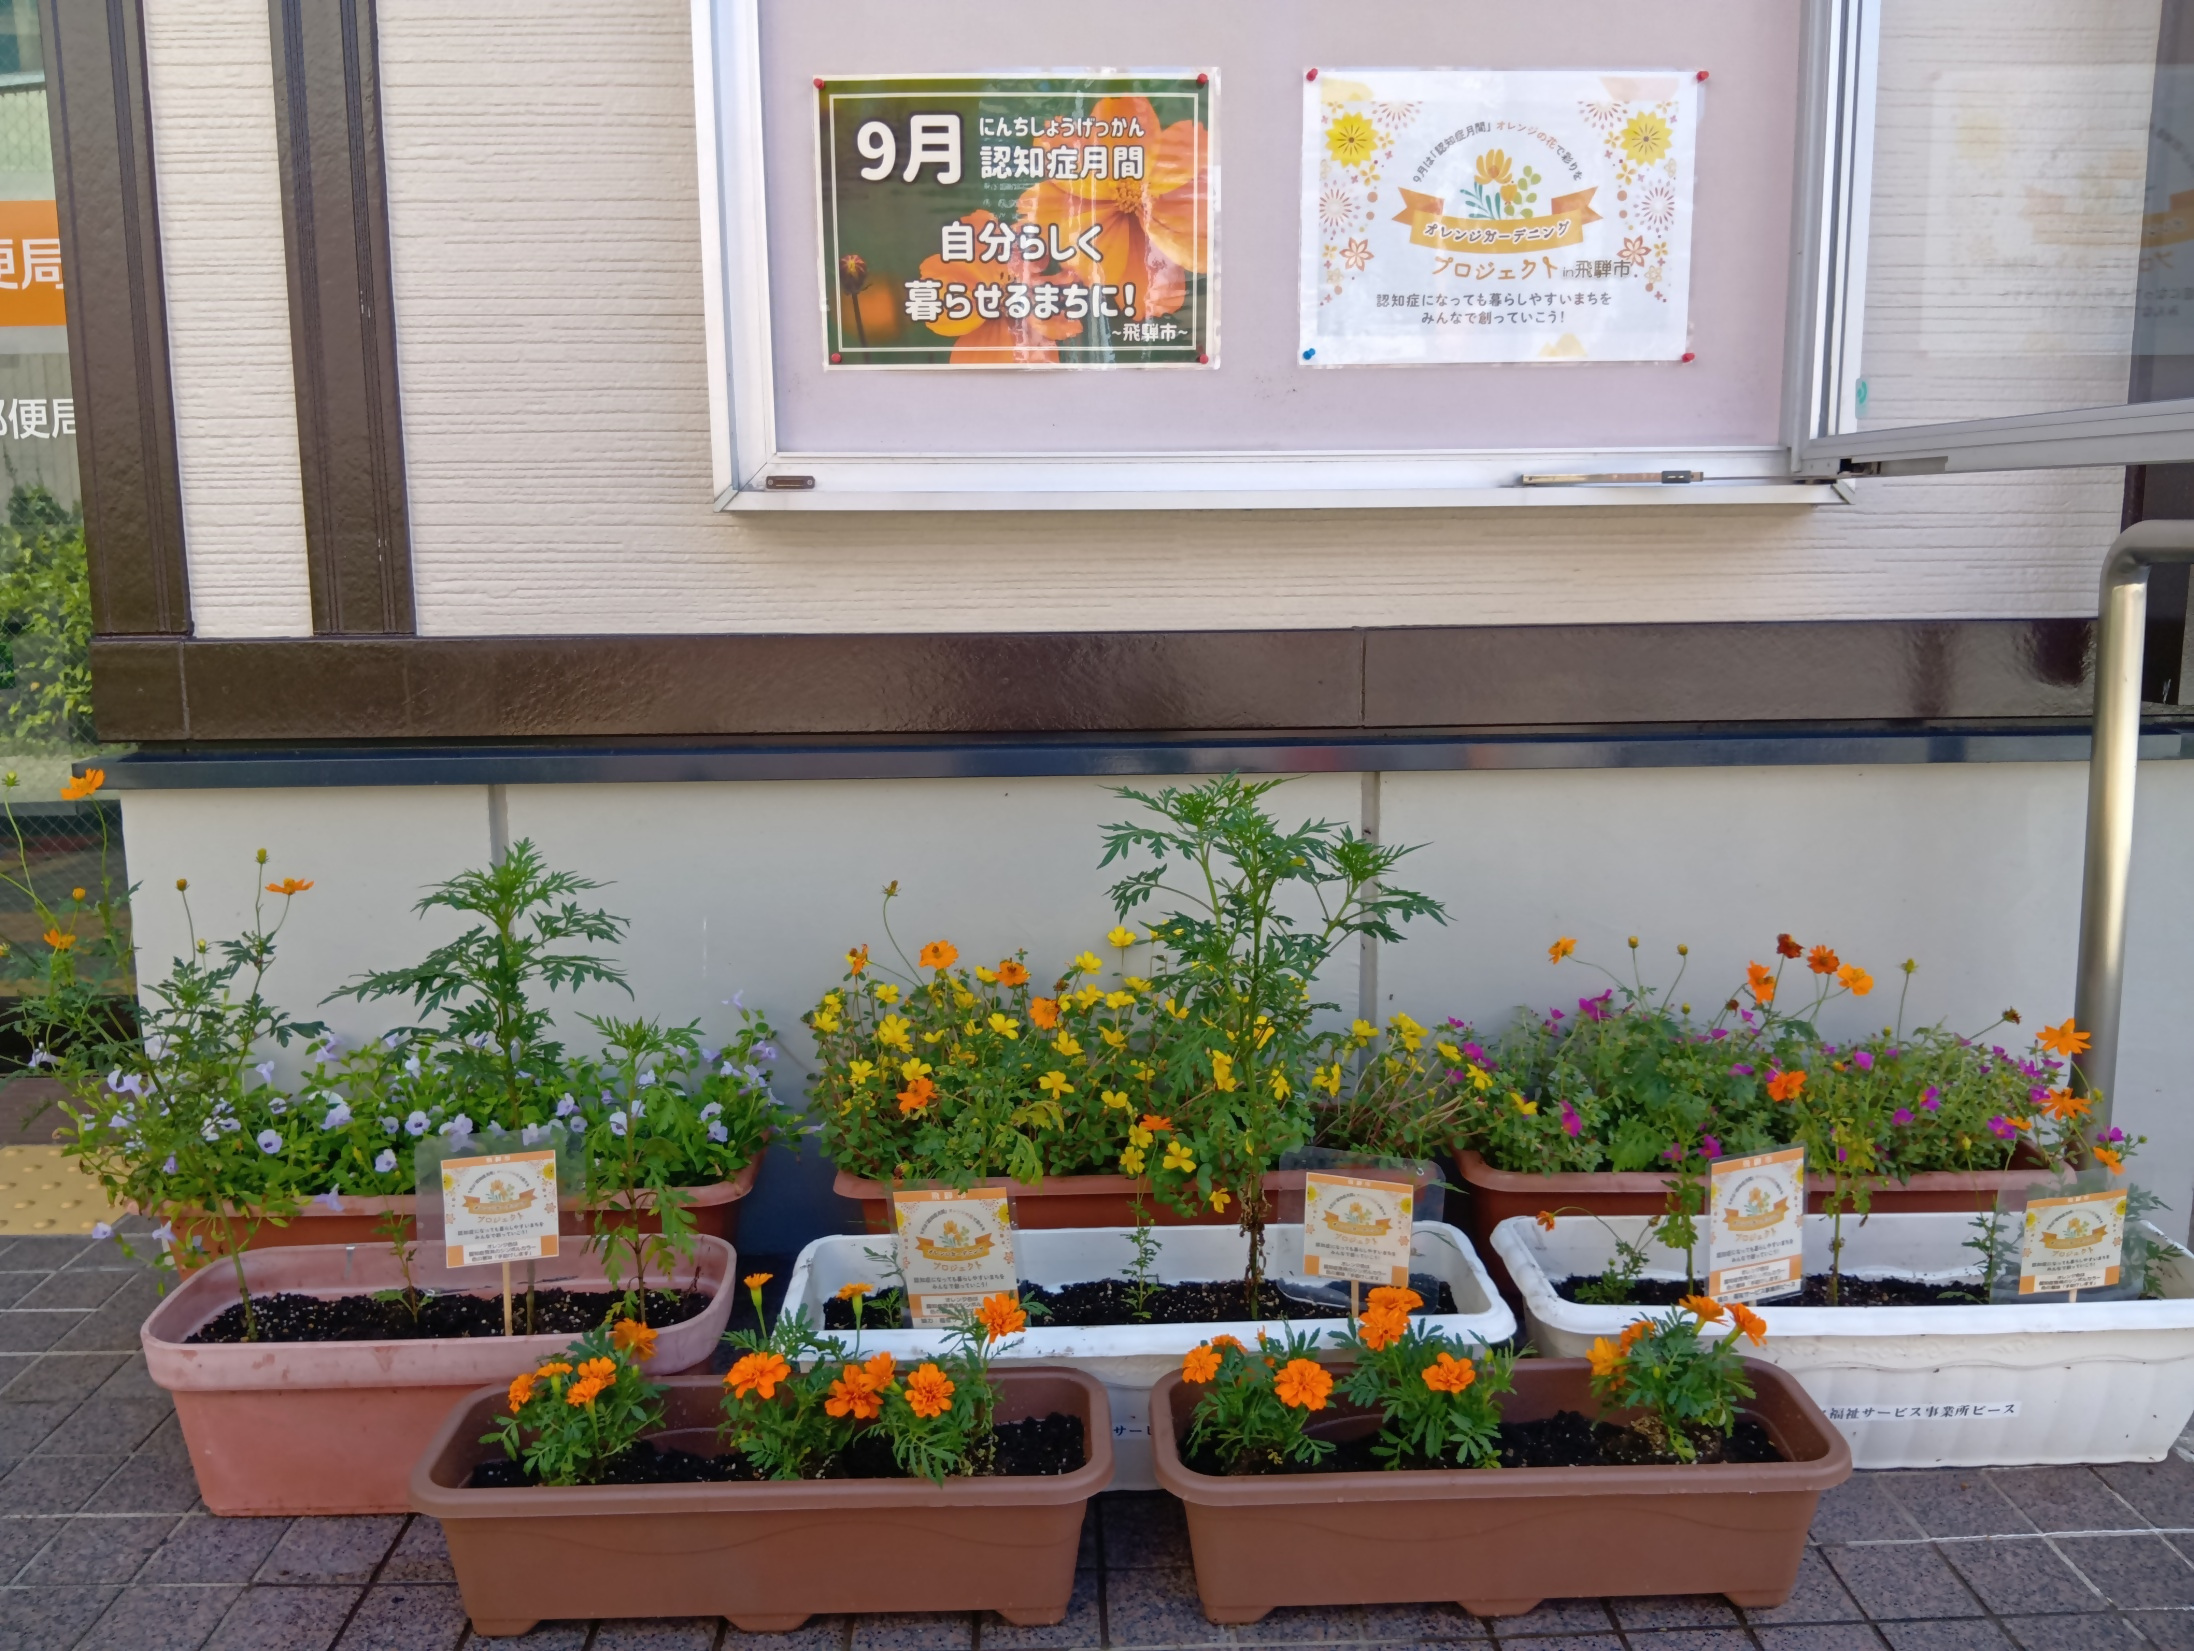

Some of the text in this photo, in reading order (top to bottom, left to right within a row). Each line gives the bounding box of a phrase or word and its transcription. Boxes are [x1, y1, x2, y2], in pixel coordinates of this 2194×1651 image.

[979, 116, 1146, 138] にんちしょうげっかん
[856, 113, 962, 185] 9月
[979, 145, 1146, 180] 認知症月間
[941, 222, 1104, 263] 自分らしく
[1423, 219, 1571, 244] オレンジガーデニング
[1432, 256, 1558, 280] プロジェクト
[904, 280, 1137, 321] 暮らせるまちに!
[1375, 293, 1612, 308] 認知症になっても暮らしやすいまちを
[1421, 311, 1565, 325] みんなで創っていこう!
[933, 1261, 982, 1272] プロジェクト
